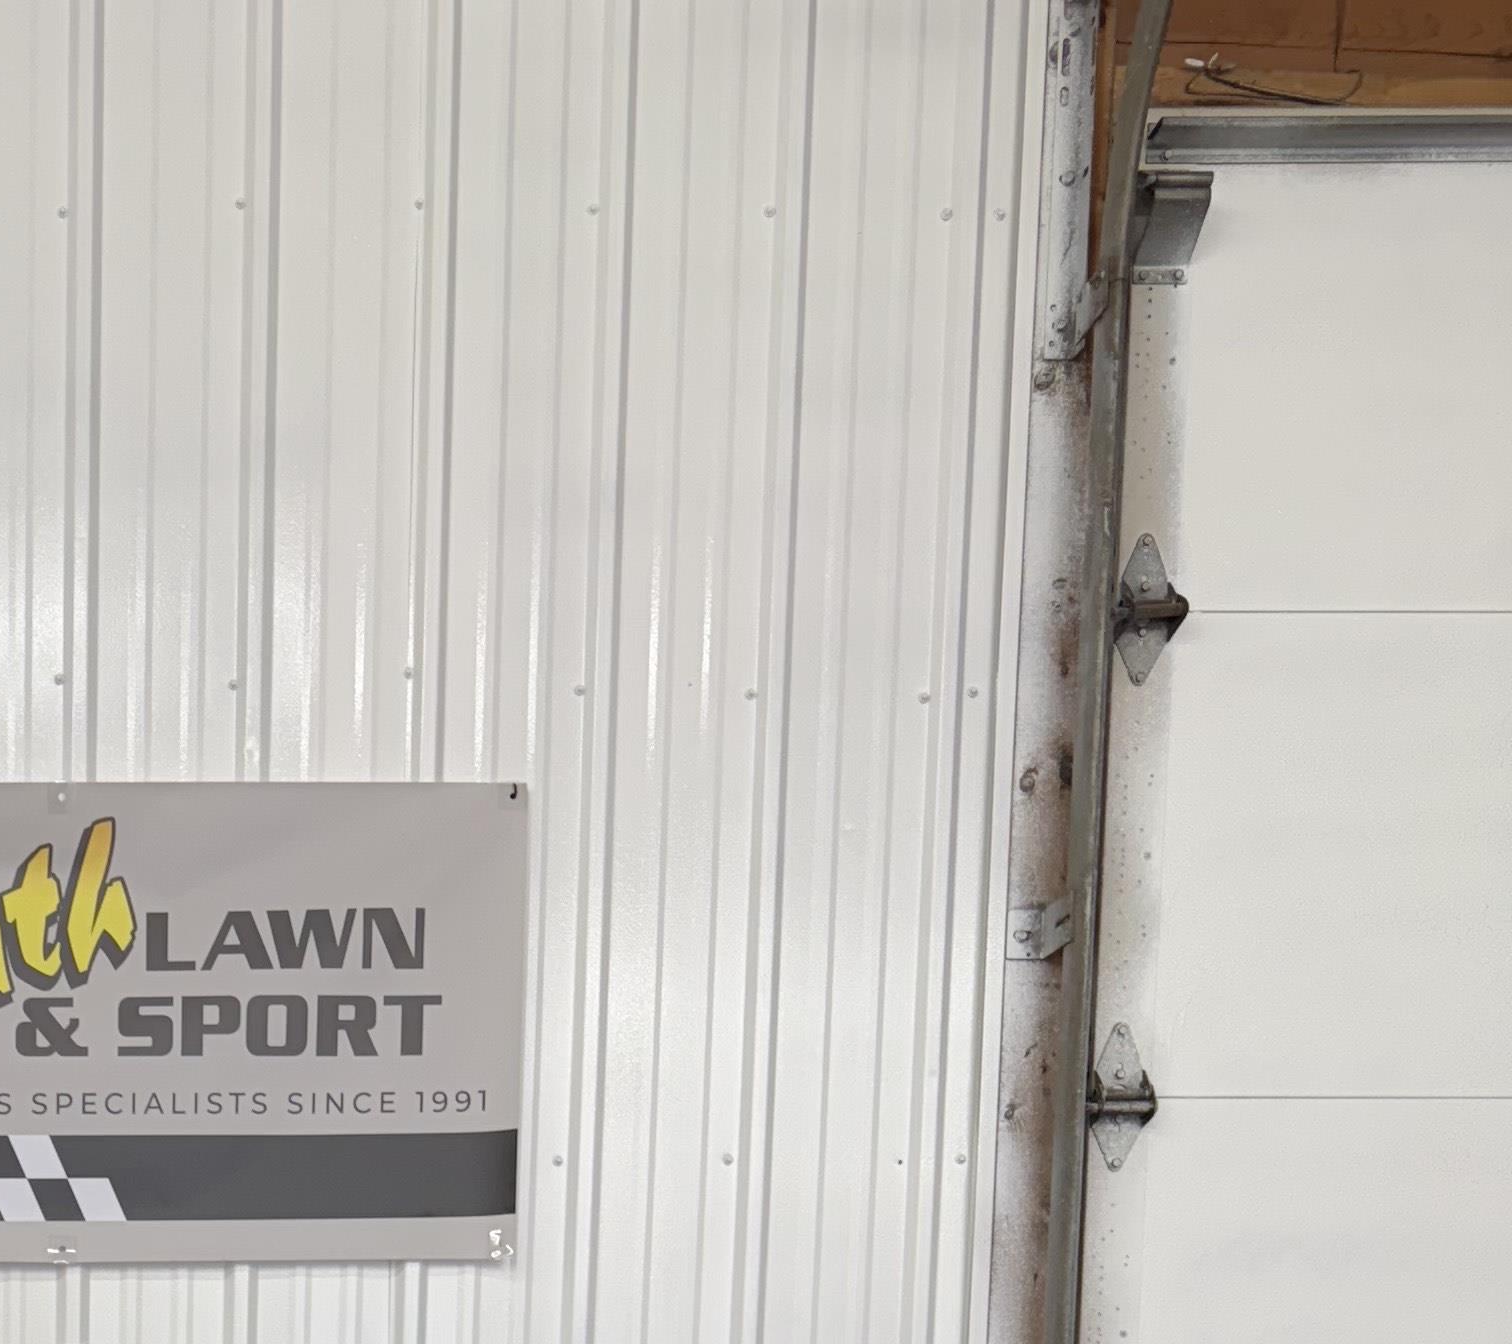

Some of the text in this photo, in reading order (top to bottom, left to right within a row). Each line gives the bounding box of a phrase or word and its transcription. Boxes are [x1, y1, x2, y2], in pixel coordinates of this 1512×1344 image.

[144, 906, 427, 972] LAWN
[15, 994, 443, 1059] & SPORT
[31, 1092, 268, 1116] SPECIALISTS
[287, 1091, 397, 1115] SINCE
[415, 1089, 488, 1113] 1991
